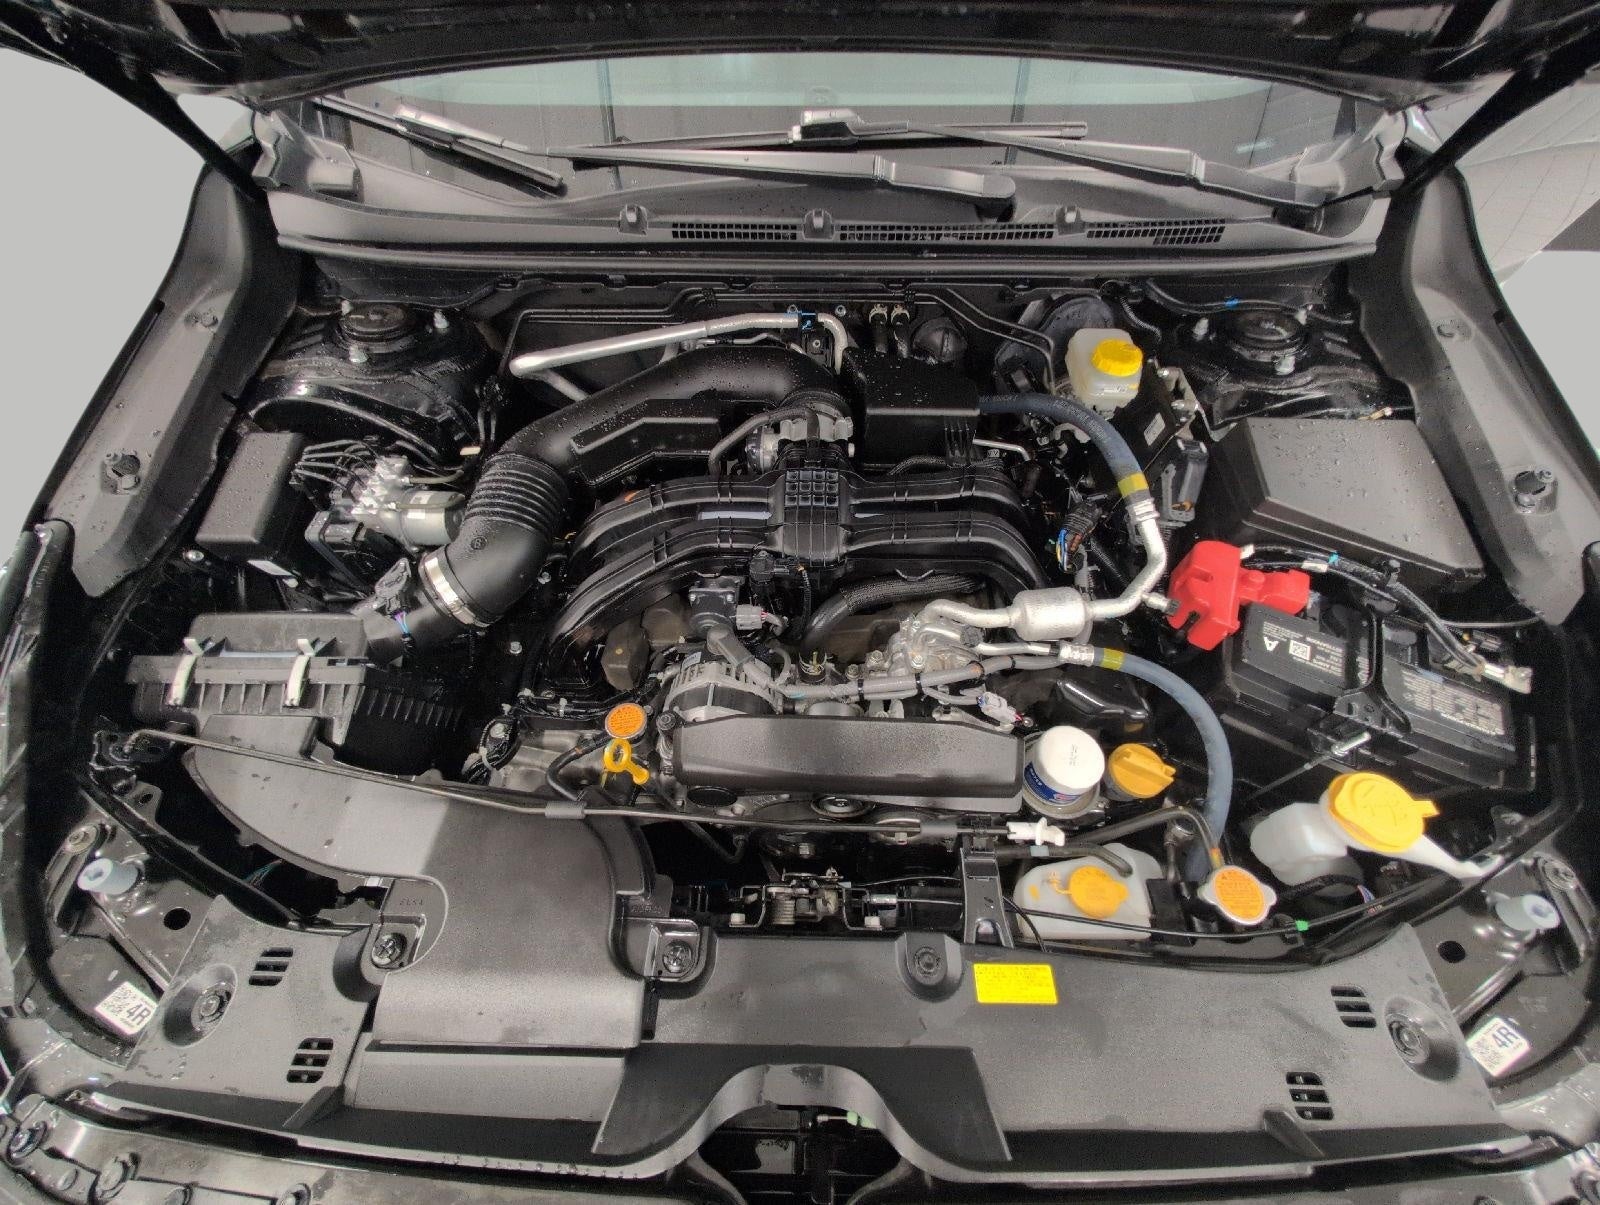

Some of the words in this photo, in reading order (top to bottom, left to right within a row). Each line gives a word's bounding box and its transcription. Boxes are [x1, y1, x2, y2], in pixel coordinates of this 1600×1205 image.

[1263, 636, 1279, 651] A
[127, 1004, 151, 1026] 4R
[1492, 1026, 1520, 1048] 4R
